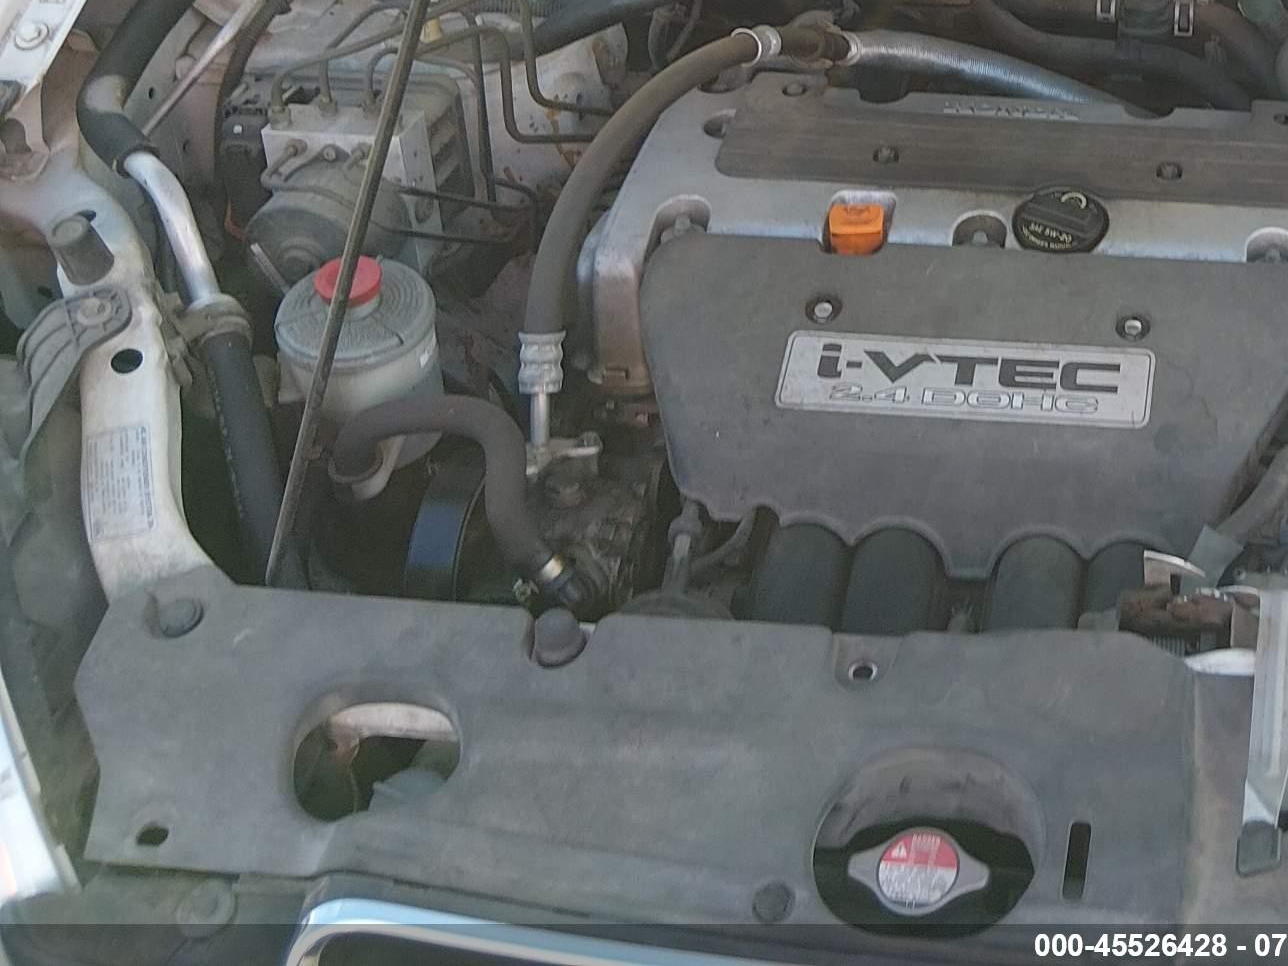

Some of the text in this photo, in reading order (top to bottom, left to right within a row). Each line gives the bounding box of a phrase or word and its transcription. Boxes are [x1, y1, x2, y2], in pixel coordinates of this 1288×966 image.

[817, 343, 1121, 394] i-VTEC
[829, 384, 1099, 414] 2.4 DOHC
